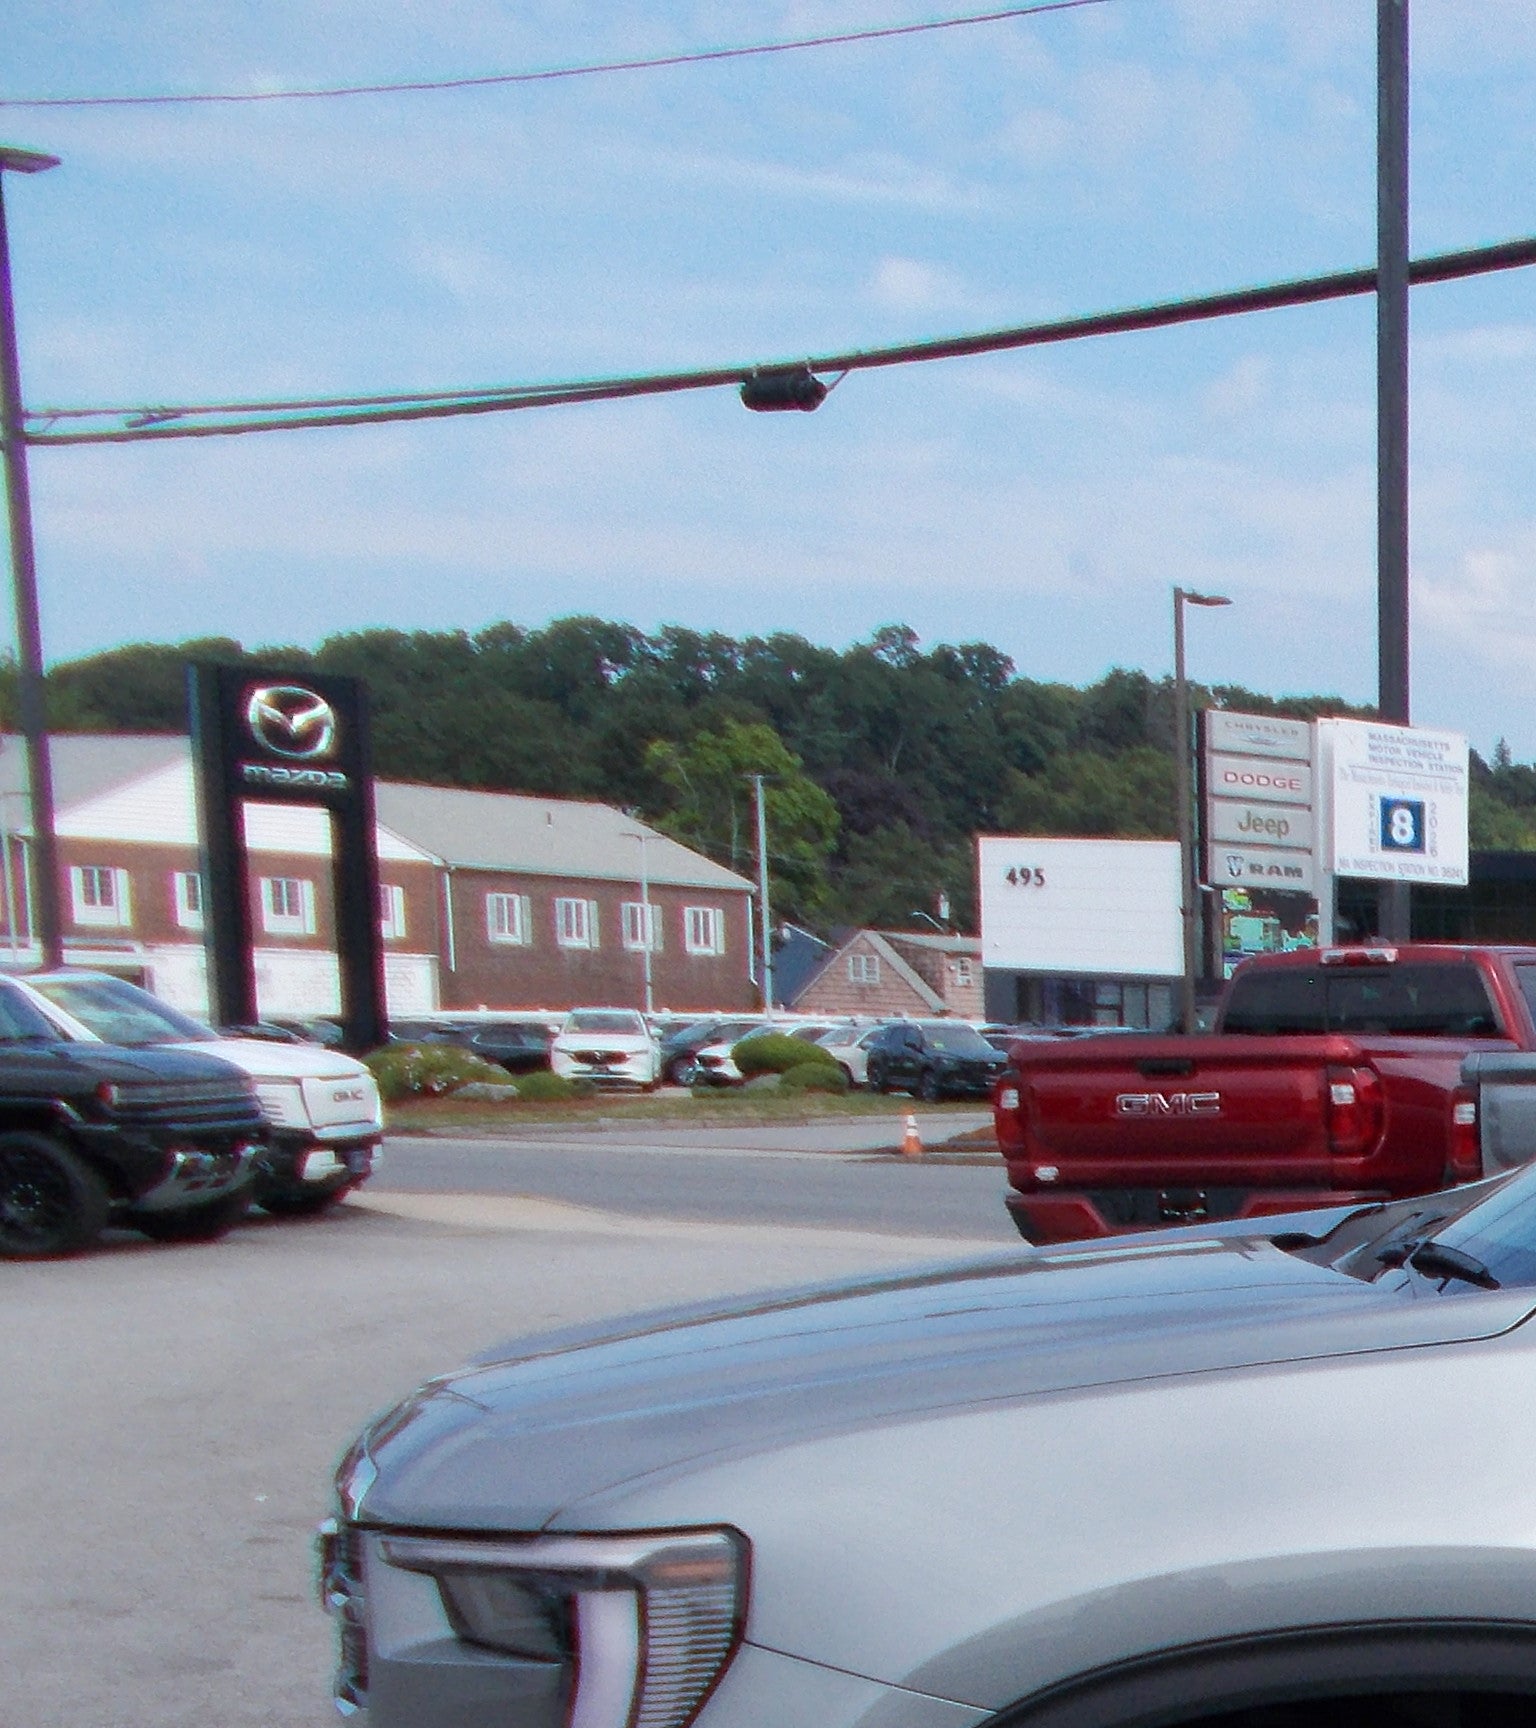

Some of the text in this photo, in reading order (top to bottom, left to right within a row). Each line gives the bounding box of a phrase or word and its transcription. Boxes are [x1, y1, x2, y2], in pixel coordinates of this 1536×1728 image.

[1225, 721, 1299, 736] CHRYSLER
[1367, 732, 1451, 751] MASSACHUSETTS
[1367, 743, 1444, 762] MOTOR VEHICLE
[1367, 754, 1464, 774] INSPECTION STATION
[1223, 771, 1302, 790] DODGE
[1238, 811, 1290, 839] Jeep
[1391, 808, 1415, 844] 8
[1006, 867, 1045, 887] 495
[1250, 863, 1304, 879] RAM
[1116, 1092, 1220, 1114] GMC
